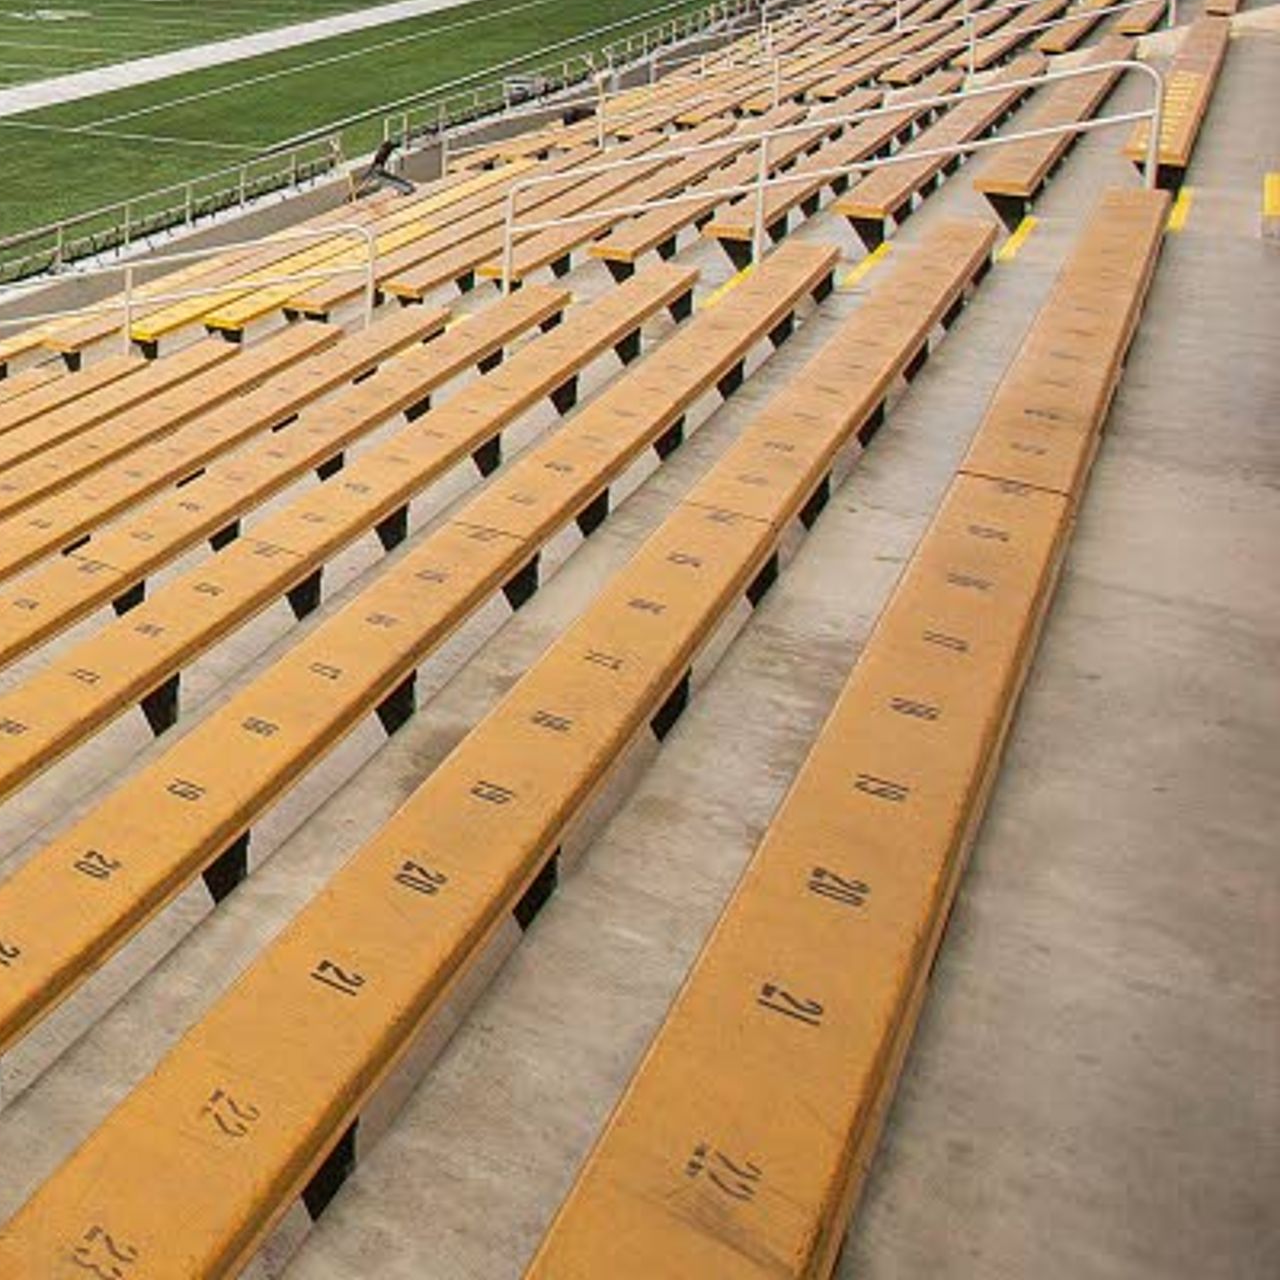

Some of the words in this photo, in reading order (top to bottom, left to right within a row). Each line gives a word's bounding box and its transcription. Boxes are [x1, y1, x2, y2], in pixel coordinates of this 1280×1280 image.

[74, 851, 121, 879] 20
[394, 861, 447, 895] 20
[808, 867, 869, 906] 20
[311, 960, 365, 996] 21
[757, 983, 824, 1026] 21
[201, 1089, 260, 1137] 22
